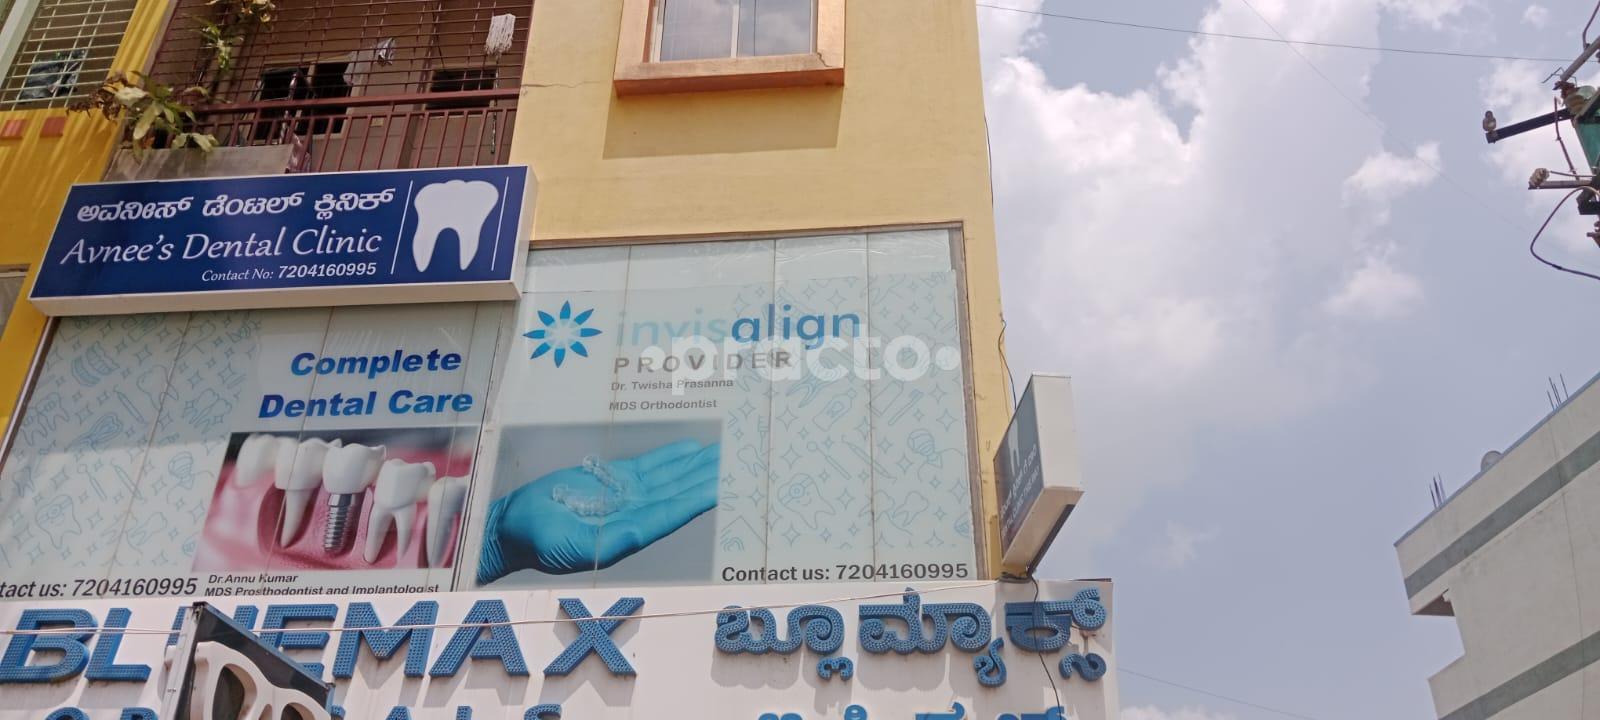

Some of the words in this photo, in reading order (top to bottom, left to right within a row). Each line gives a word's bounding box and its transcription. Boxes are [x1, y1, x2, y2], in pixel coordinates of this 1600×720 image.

[202, 192, 304, 217] ಡೆಂಟಲ್
[314, 188, 396, 220] ಕ್ಲಿನಿಕ್
[182, 226, 287, 260] Dental
[292, 224, 382, 255] Clinic
[201, 269, 250, 282] Contact
[252, 267, 274, 281] No:
[278, 262, 377, 279] 7204160995
[615, 303, 861, 351] invisalign
[290, 348, 462, 379] Complete
[614, 351, 793, 374] PROVIDER
[611, 382, 628, 392] Dr.
[631, 380, 673, 391] Twisha
[676, 378, 734, 389] Prasanna
[258, 390, 377, 418] Dental
[388, 390, 473, 414] Care
[609, 401, 637, 411] MDS
[640, 399, 717, 411] Orthodontist
[258, 574, 298, 583] Kumar
[721, 566, 798, 583] Contact
[802, 567, 830, 581] us:
[836, 563, 968, 580] 7204160995
[39, 583, 67, 597] us:
[72, 578, 198, 597] 7204160995
[204, 587, 232, 597] MDS
[235, 585, 323, 596] Prosthodontist
[325, 585, 349, 595] and
[0, 596, 646, 685] BLEMAX
